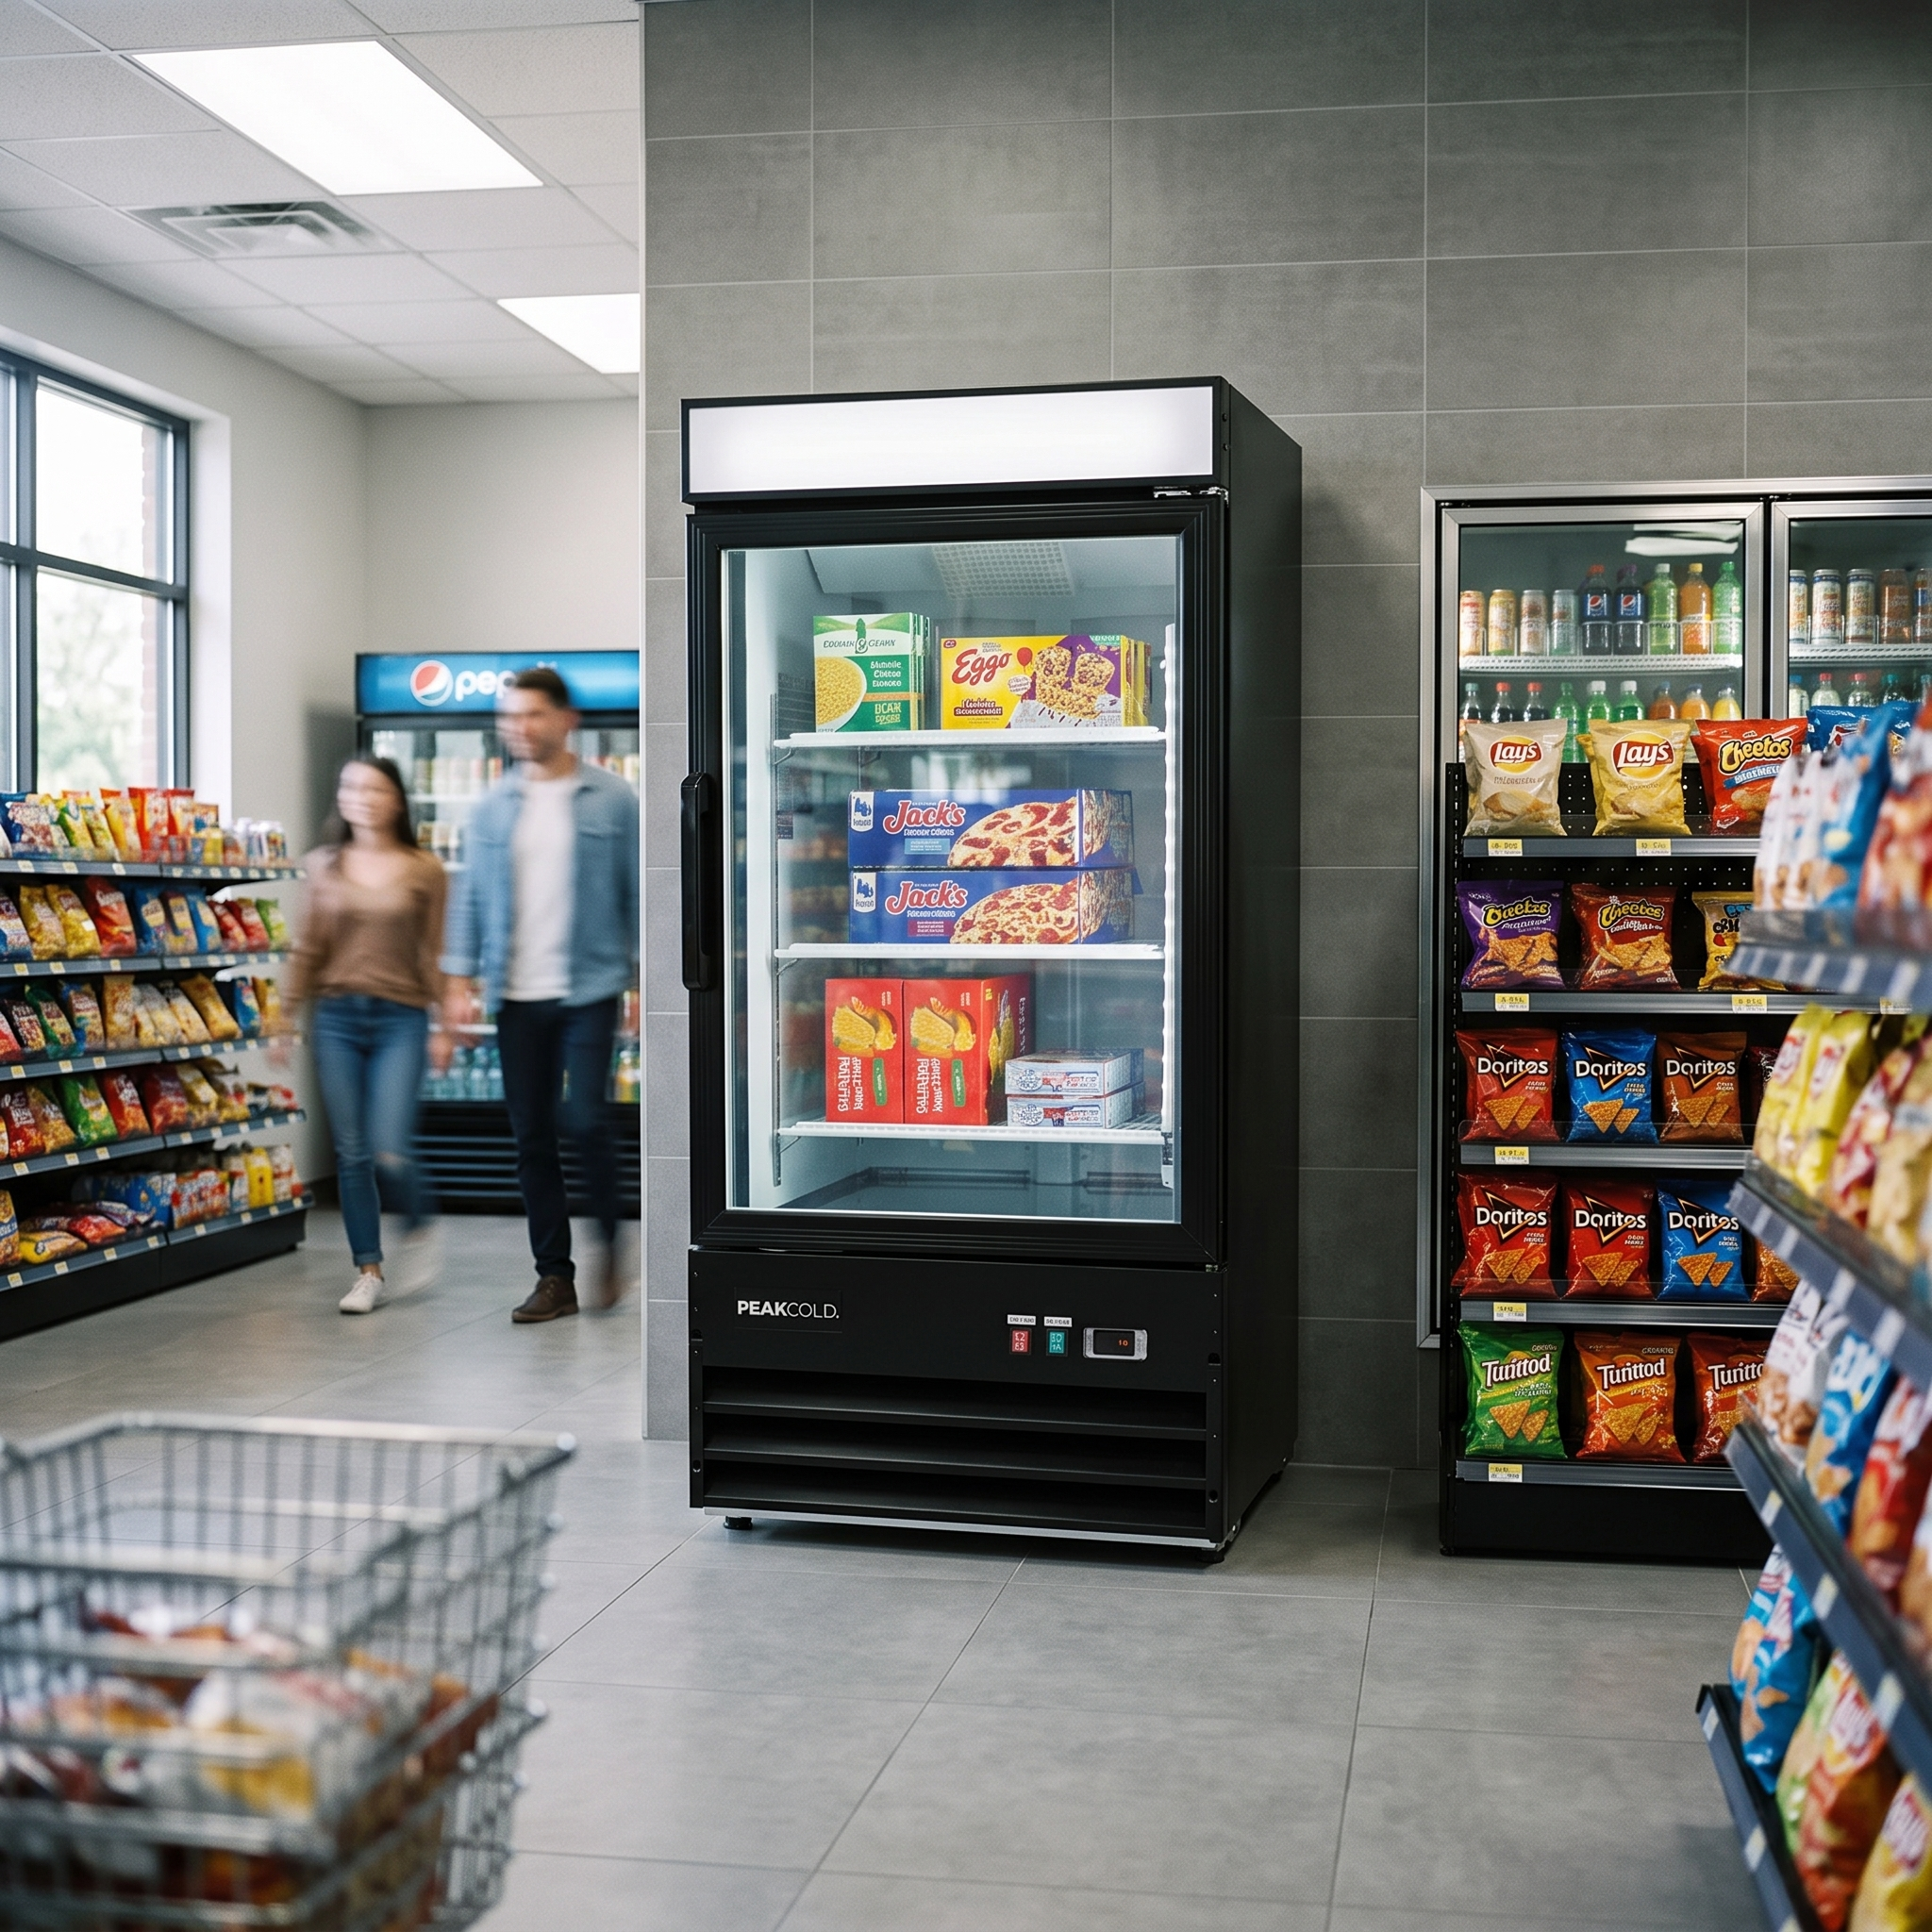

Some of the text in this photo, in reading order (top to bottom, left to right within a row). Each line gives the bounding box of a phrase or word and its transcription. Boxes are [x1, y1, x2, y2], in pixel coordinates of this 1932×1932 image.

[951, 648, 1013, 687] Eggo
[454, 670, 517, 702] pep
[1720, 735, 1792, 774] Cheetos
[883, 800, 967, 835] Jack's
[885, 880, 969, 915] Jack's
[1477, 1057, 1549, 1074] Doritos
[1574, 1060, 1646, 1077] Doritos
[1666, 1059, 1736, 1076] Doritos
[1476, 1208, 1547, 1226] Doritos
[1574, 1209, 1646, 1229] Doritos
[1669, 1211, 1740, 1230] Doritos
